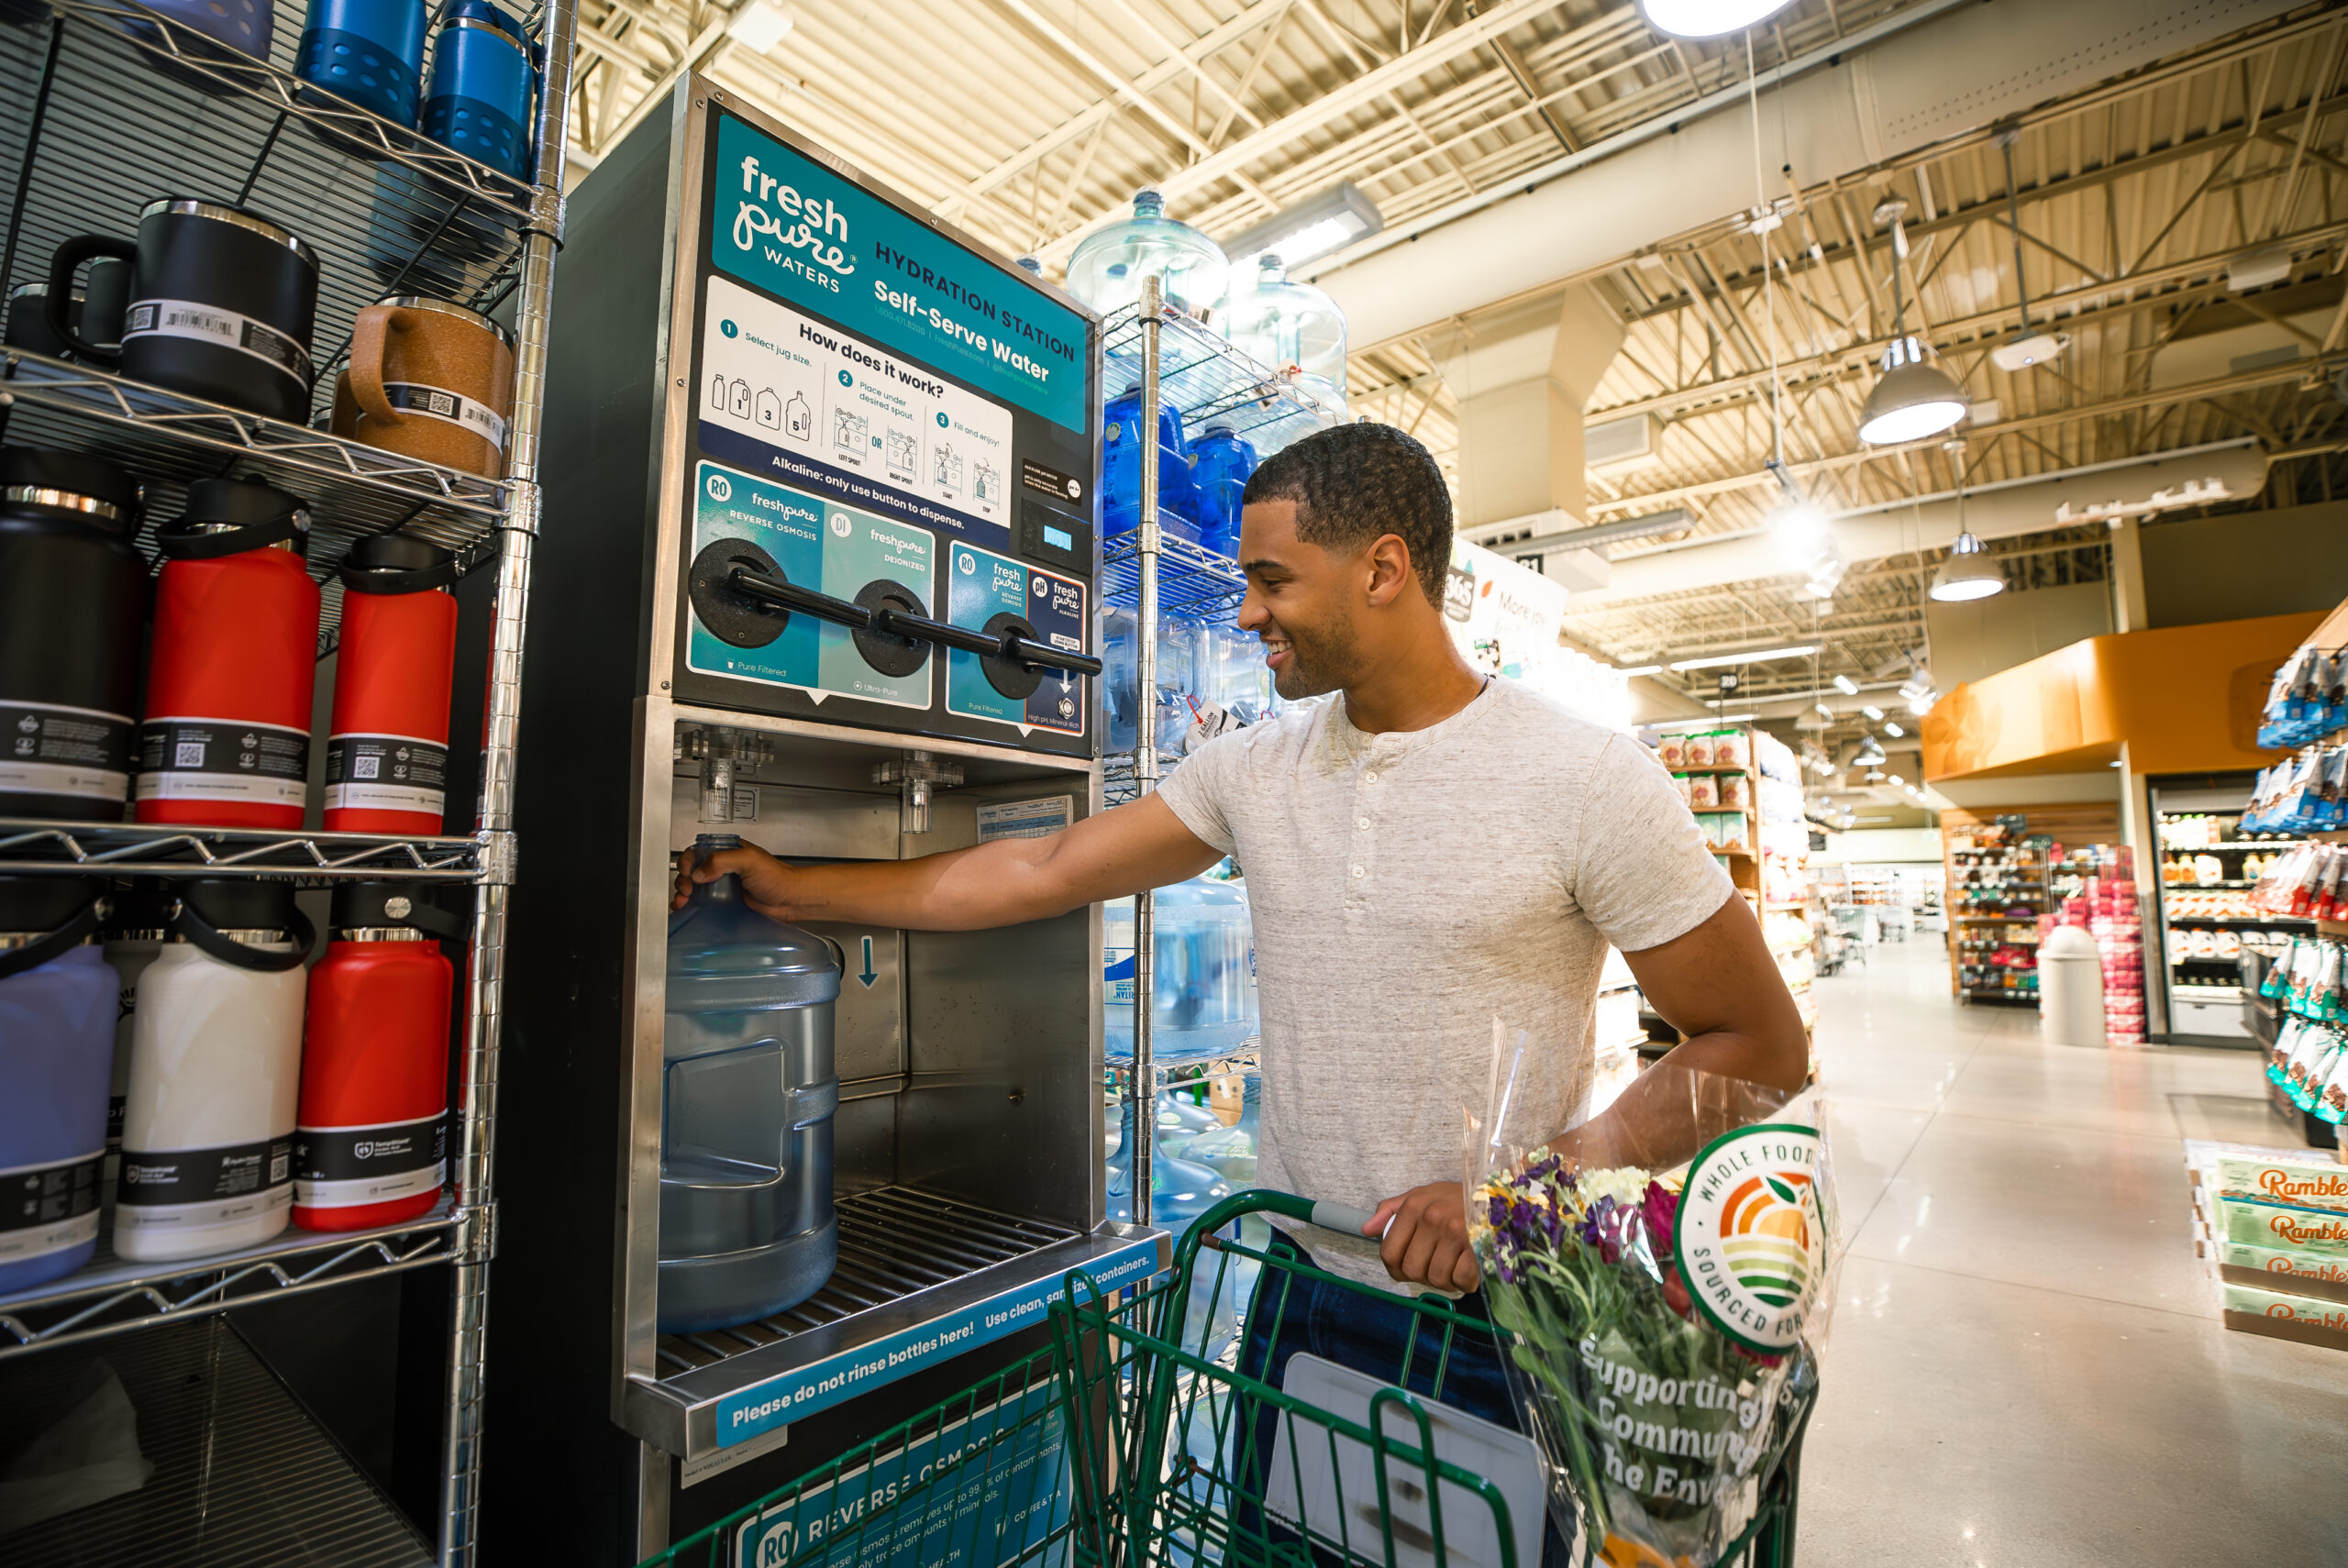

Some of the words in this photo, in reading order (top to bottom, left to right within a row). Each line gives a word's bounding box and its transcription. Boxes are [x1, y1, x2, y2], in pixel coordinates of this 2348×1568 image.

[741, 156, 847, 243] fresh
[763, 246, 840, 293] WATERS
[875, 242, 996, 321] HYDRATION
[1002, 310, 1075, 362] STATION
[874, 280, 988, 352] Self-Serve
[991, 338, 1049, 382] Water
[745, 332, 774, 351] Select
[775, 346, 792, 360] jug
[792, 353, 812, 367] size.
[799, 323, 837, 352] How
[841, 344, 881, 371] does
[884, 360, 896, 379] it
[899, 370, 944, 399] work?
[737, 399, 743, 410] 1
[859, 381, 881, 397] Place
[883, 392, 907, 407] under
[764, 410, 772, 421] 3
[859, 392, 890, 411] desired
[891, 406, 914, 421] spout.
[792, 420, 800, 431] 5
[954, 421, 963, 432] Fill
[964, 425, 979, 437] and
[980, 434, 1000, 447] enjoy!
[871, 436, 882, 449] OR
[838, 454, 847, 462] LEFT
[847, 456, 861, 467] SPOUT
[711, 479, 726, 498] RO
[900, 475, 913, 486] SPOUT
[772, 456, 823, 481] Alkaline:
[825, 476, 850, 492] only
[851, 482, 870, 497] use
[872, 487, 908, 509] button
[908, 500, 918, 513] to
[919, 504, 965, 529] dispense.
[751, 492, 819, 522] freshpure
[729, 509, 773, 529] REVERSE
[776, 521, 816, 541] OSMOSIS
[836, 517, 847, 533] DI
[870, 528, 926, 555] freshpure
[884, 554, 925, 572] DEIONIZED
[961, 556, 973, 571] RO
[993, 562, 1021, 581] fresh
[1001, 591, 1022, 602] REVERSE
[1035, 580, 1046, 594] pH
[1053, 581, 1078, 600] fresh
[1001, 598, 1022, 608] OSMOSIS
[1058, 609, 1080, 619] ALKALINE
[737, 660, 757, 672] Pure
[758, 664, 786, 677] Filtered
[969, 702, 982, 712] Pure
[982, 705, 1002, 715] Filtered
[1028, 714, 1040, 723] High
[1201, 712, 1214, 730] GALLON
[1115, 991, 1135, 999] RITAN
[1698, 1151, 1753, 1203] WHOLE
[2259, 1169, 2348, 1201] Ramble
[1694, 1248, 1767, 1332] SOURCED
[1776, 1312, 1803, 1337] FOR
[732, 1395, 791, 1429] Please
[793, 1382, 816, 1405] do
[818, 1372, 845, 1395] not
[847, 1358, 886, 1385] rinse
[888, 1337, 937, 1370] bottles
[939, 1320, 974, 1347] here!
[985, 1309, 1008, 1329] Use
[1009, 1297, 1045, 1320] clean,
[1046, 1275, 1096, 1305] sanize
[1095, 1255, 1150, 1285] containers.
[1579, 1338, 1762, 1430] Supporting
[1013, 1501, 1041, 1523] COFEE
[1041, 1496, 1047, 1507] &
[1048, 1489, 1062, 1502] TA
[854, 1533, 898, 1560] smoss
[958, 1492, 967, 1503] to
[764, 1529, 792, 1568] RO
